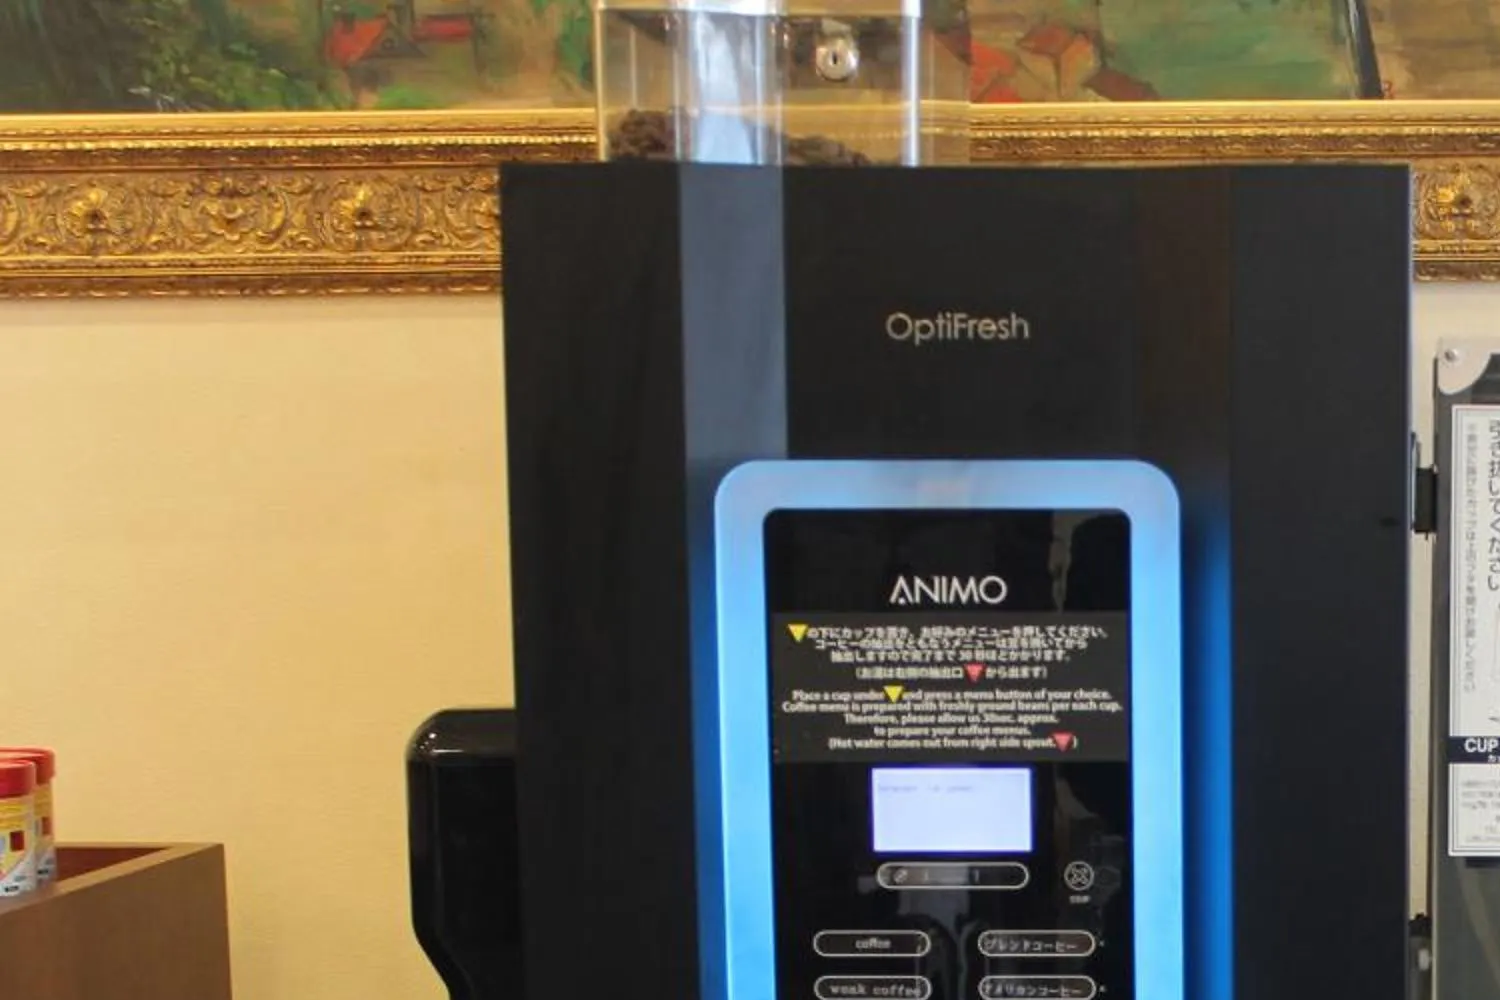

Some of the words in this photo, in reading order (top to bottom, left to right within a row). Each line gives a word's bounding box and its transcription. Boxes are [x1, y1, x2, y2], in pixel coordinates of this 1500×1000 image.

[885, 312, 1030, 346] OptiFresh
[889, 576, 1007, 604] ANIMO
[1464, 739, 1498, 753] CUP
[855, 937, 891, 949] coffee
[830, 983, 866, 995] weak
[872, 983, 921, 997] coffee
